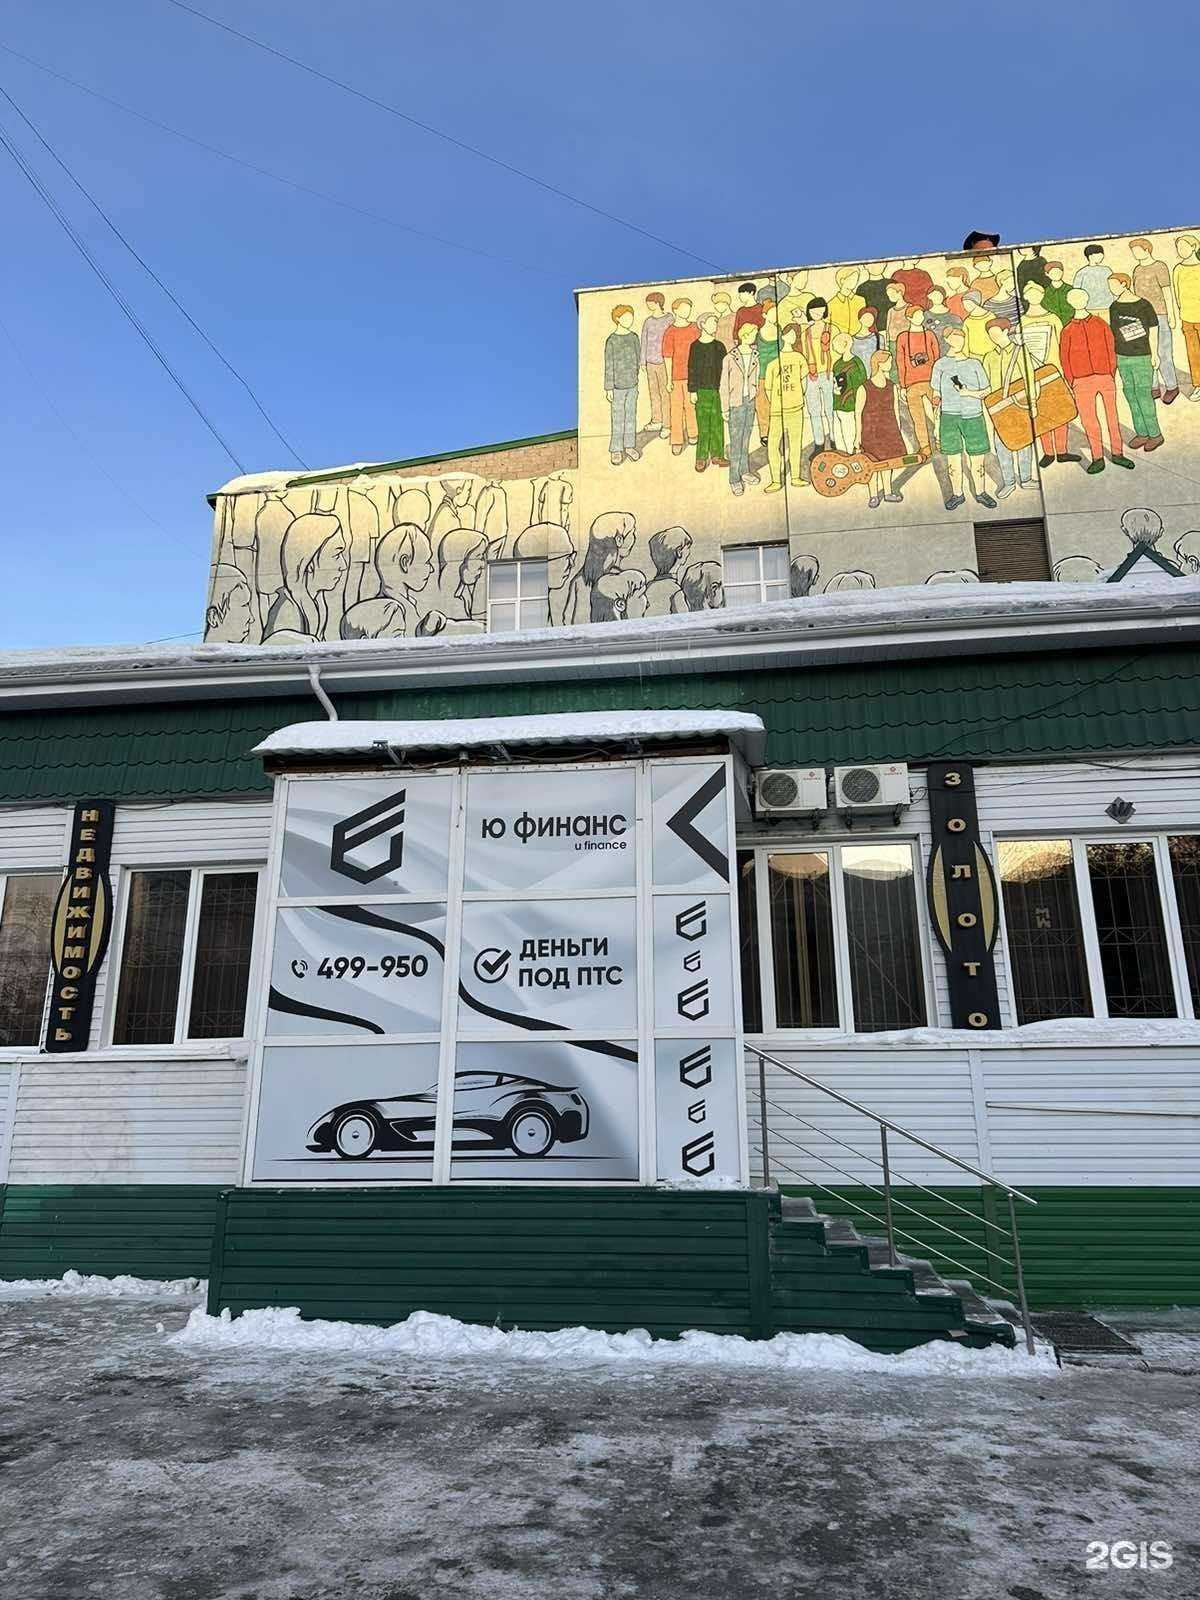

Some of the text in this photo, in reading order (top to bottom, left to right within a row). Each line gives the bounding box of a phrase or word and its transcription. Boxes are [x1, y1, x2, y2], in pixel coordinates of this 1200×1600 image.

[513, 811, 627, 844] финанс
[584, 840, 627, 851] finance
[944, 772, 988, 1028] ЗОЛОТО
[55, 809, 100, 1042] НЕДВИЖИМОСТЬ
[519, 937, 608, 961] ДЕНЬГИ
[317, 954, 428, 979] 499-950
[518, 965, 623, 989] ПОД ПТС
